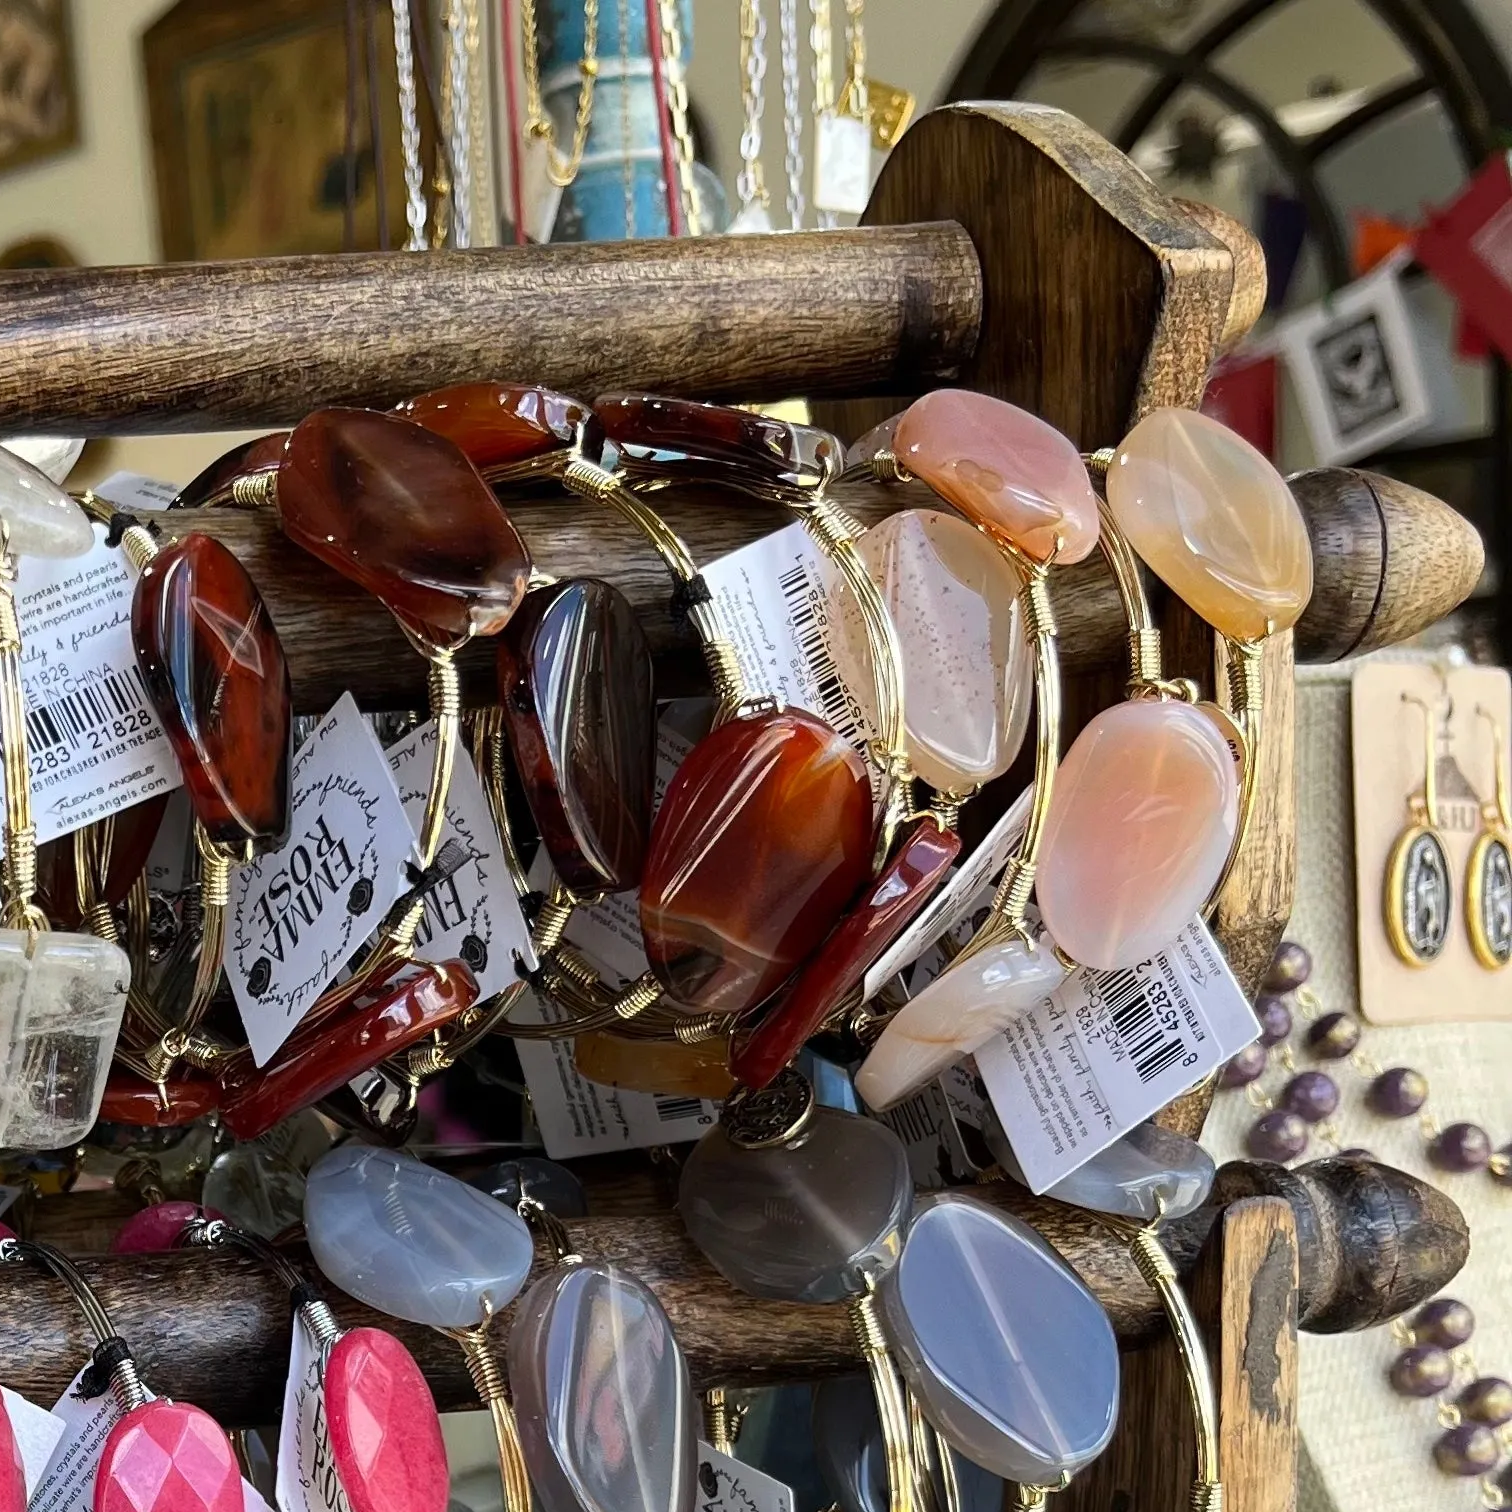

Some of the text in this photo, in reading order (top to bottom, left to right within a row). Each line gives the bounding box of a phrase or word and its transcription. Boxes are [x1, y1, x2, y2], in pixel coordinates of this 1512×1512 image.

[19, 581, 62, 608] crystals
[60, 572, 83, 588] and
[83, 558, 119, 582] pearls
[19, 604, 43, 621] wire
[44, 599, 62, 611] are
[62, 569, 129, 603] handcrafted
[38, 600, 94, 632] important
[92, 595, 105, 607] in
[783, 615, 808, 666] CHINA
[20, 661, 70, 693] 21828
[43, 661, 114, 702] IN CHINA
[788, 657, 813, 706] 21828
[86, 708, 153, 749] 21828
[99, 741, 128, 761] UNDER
[54, 775, 168, 830] alexas-angels.com
[249, 814, 336, 936] ROSE
[260, 836, 356, 963] EMMA
[285, 949, 334, 1016] faith
[1073, 1005, 1102, 1044] 21829
[1092, 1005, 1127, 1062] MADE IN
[1146, 980, 1199, 1066] 8 45283
[1051, 1072, 1063, 1084] of
[1056, 1031, 1111, 1117] faith, family
[1019, 1069, 1064, 1155] Beautiful gemstones,
[1032, 1066, 1079, 1149] wrapped on delicate
[1056, 1083, 1080, 1121] reminder
[1077, 1126, 1088, 1137] as
[52, 1395, 117, 1475] crystals and pearls
[58, 1466, 77, 1488] wire
[74, 1454, 88, 1470] are
